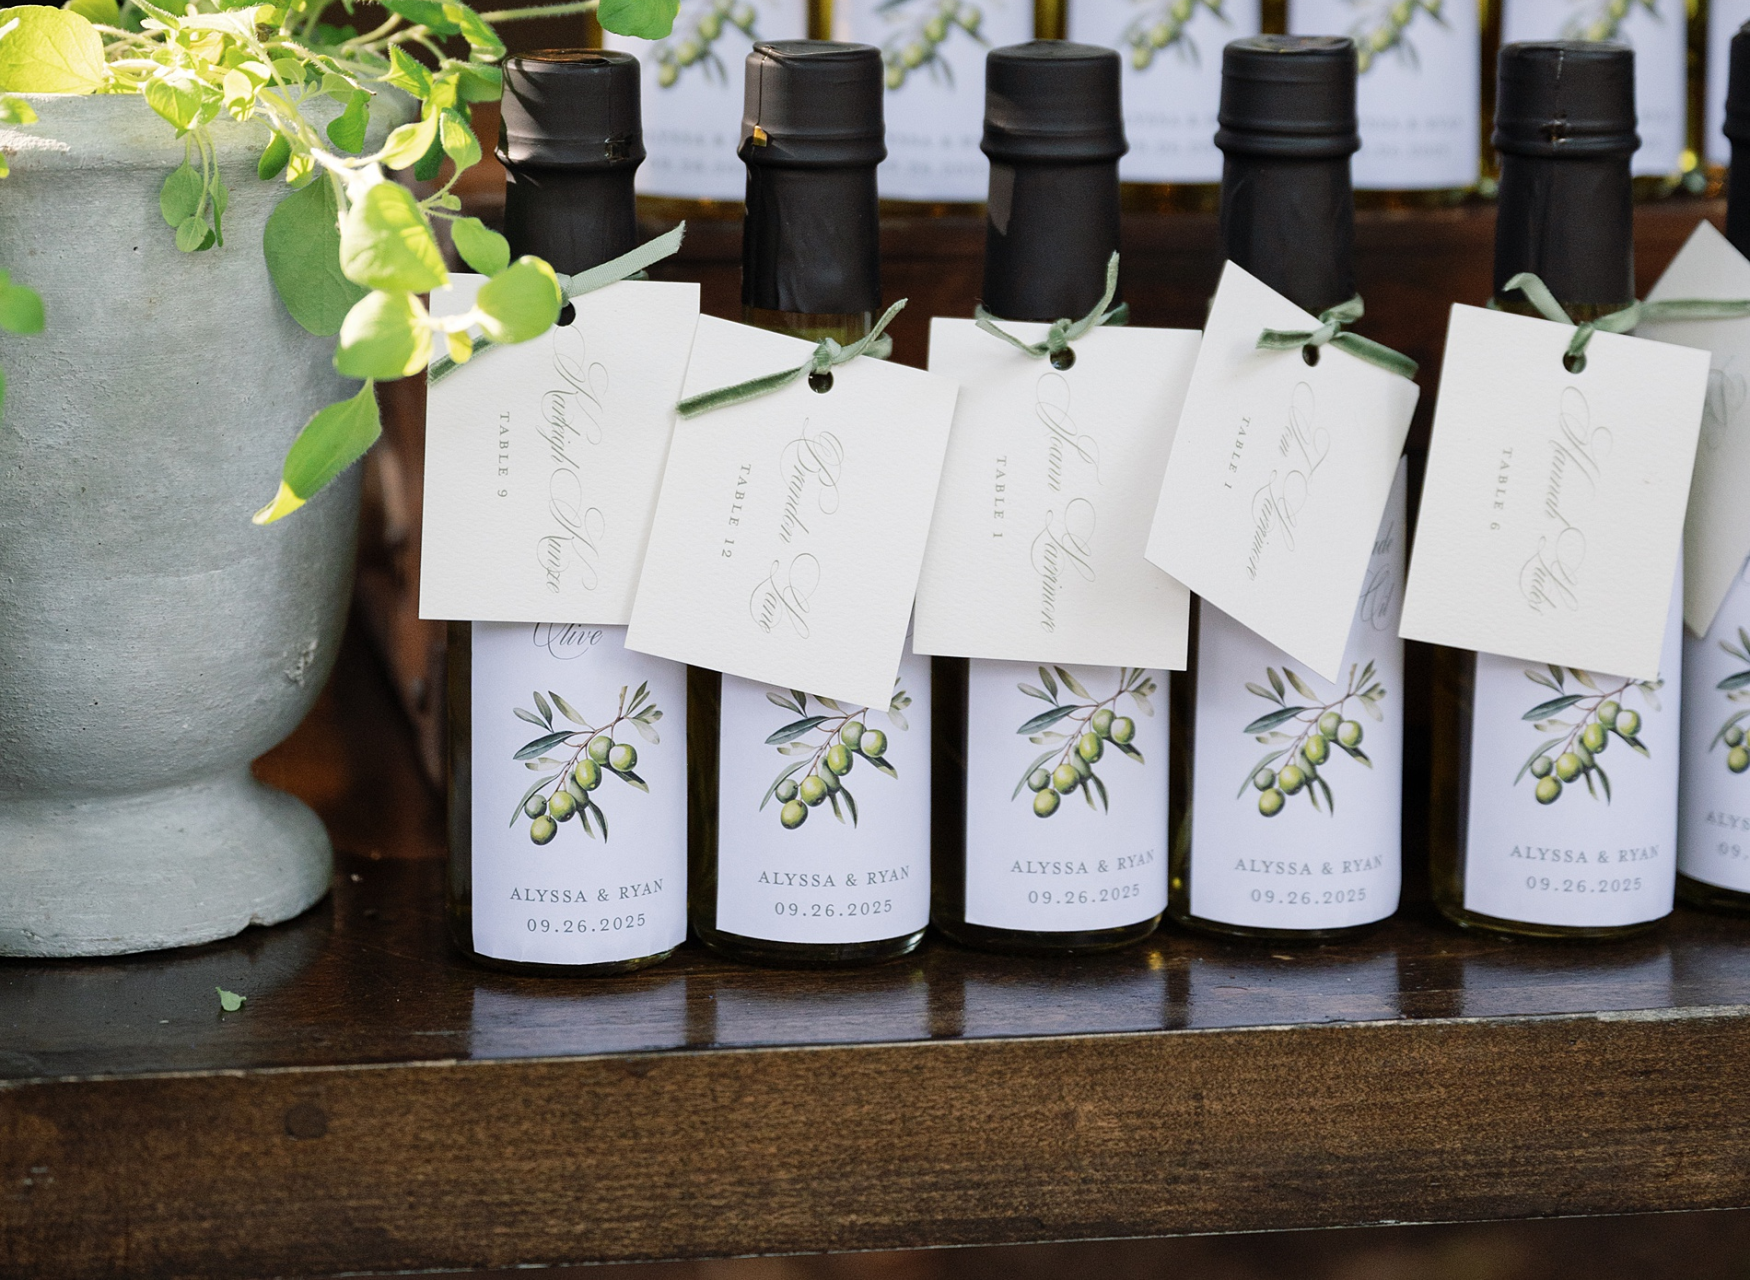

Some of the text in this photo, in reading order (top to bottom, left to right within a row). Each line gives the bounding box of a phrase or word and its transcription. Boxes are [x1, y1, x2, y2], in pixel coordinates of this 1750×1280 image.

[1035, 372, 1103, 493] Joann
[497, 412, 510, 498] TABLE 9
[1229, 417, 1251, 473] TABLE
[1544, 386, 1612, 529] Hannah
[994, 456, 1007, 518] TABLE
[1490, 448, 1513, 531] TABLE 6
[721, 464, 751, 558] TABLE 12
[750, 417, 844, 640] Brandon Lane
[1011, 851, 1153, 875] ALYSSA & RYAN
[1235, 856, 1381, 875] ALYSSA & RYAN
[1510, 845, 1658, 863] ALYSSA & RYAN
[758, 866, 909, 887] ALYSSA & RYAN
[1526, 876, 1641, 893] 09.26.2025
[510, 879, 662, 903] ALYSSA & RYAN
[1028, 884, 1139, 904] 09.26.2025
[1250, 888, 1366, 905] 09.26.2025
[775, 899, 892, 917] 09.26.2025
[527, 913, 645, 933] 09.26.2025
